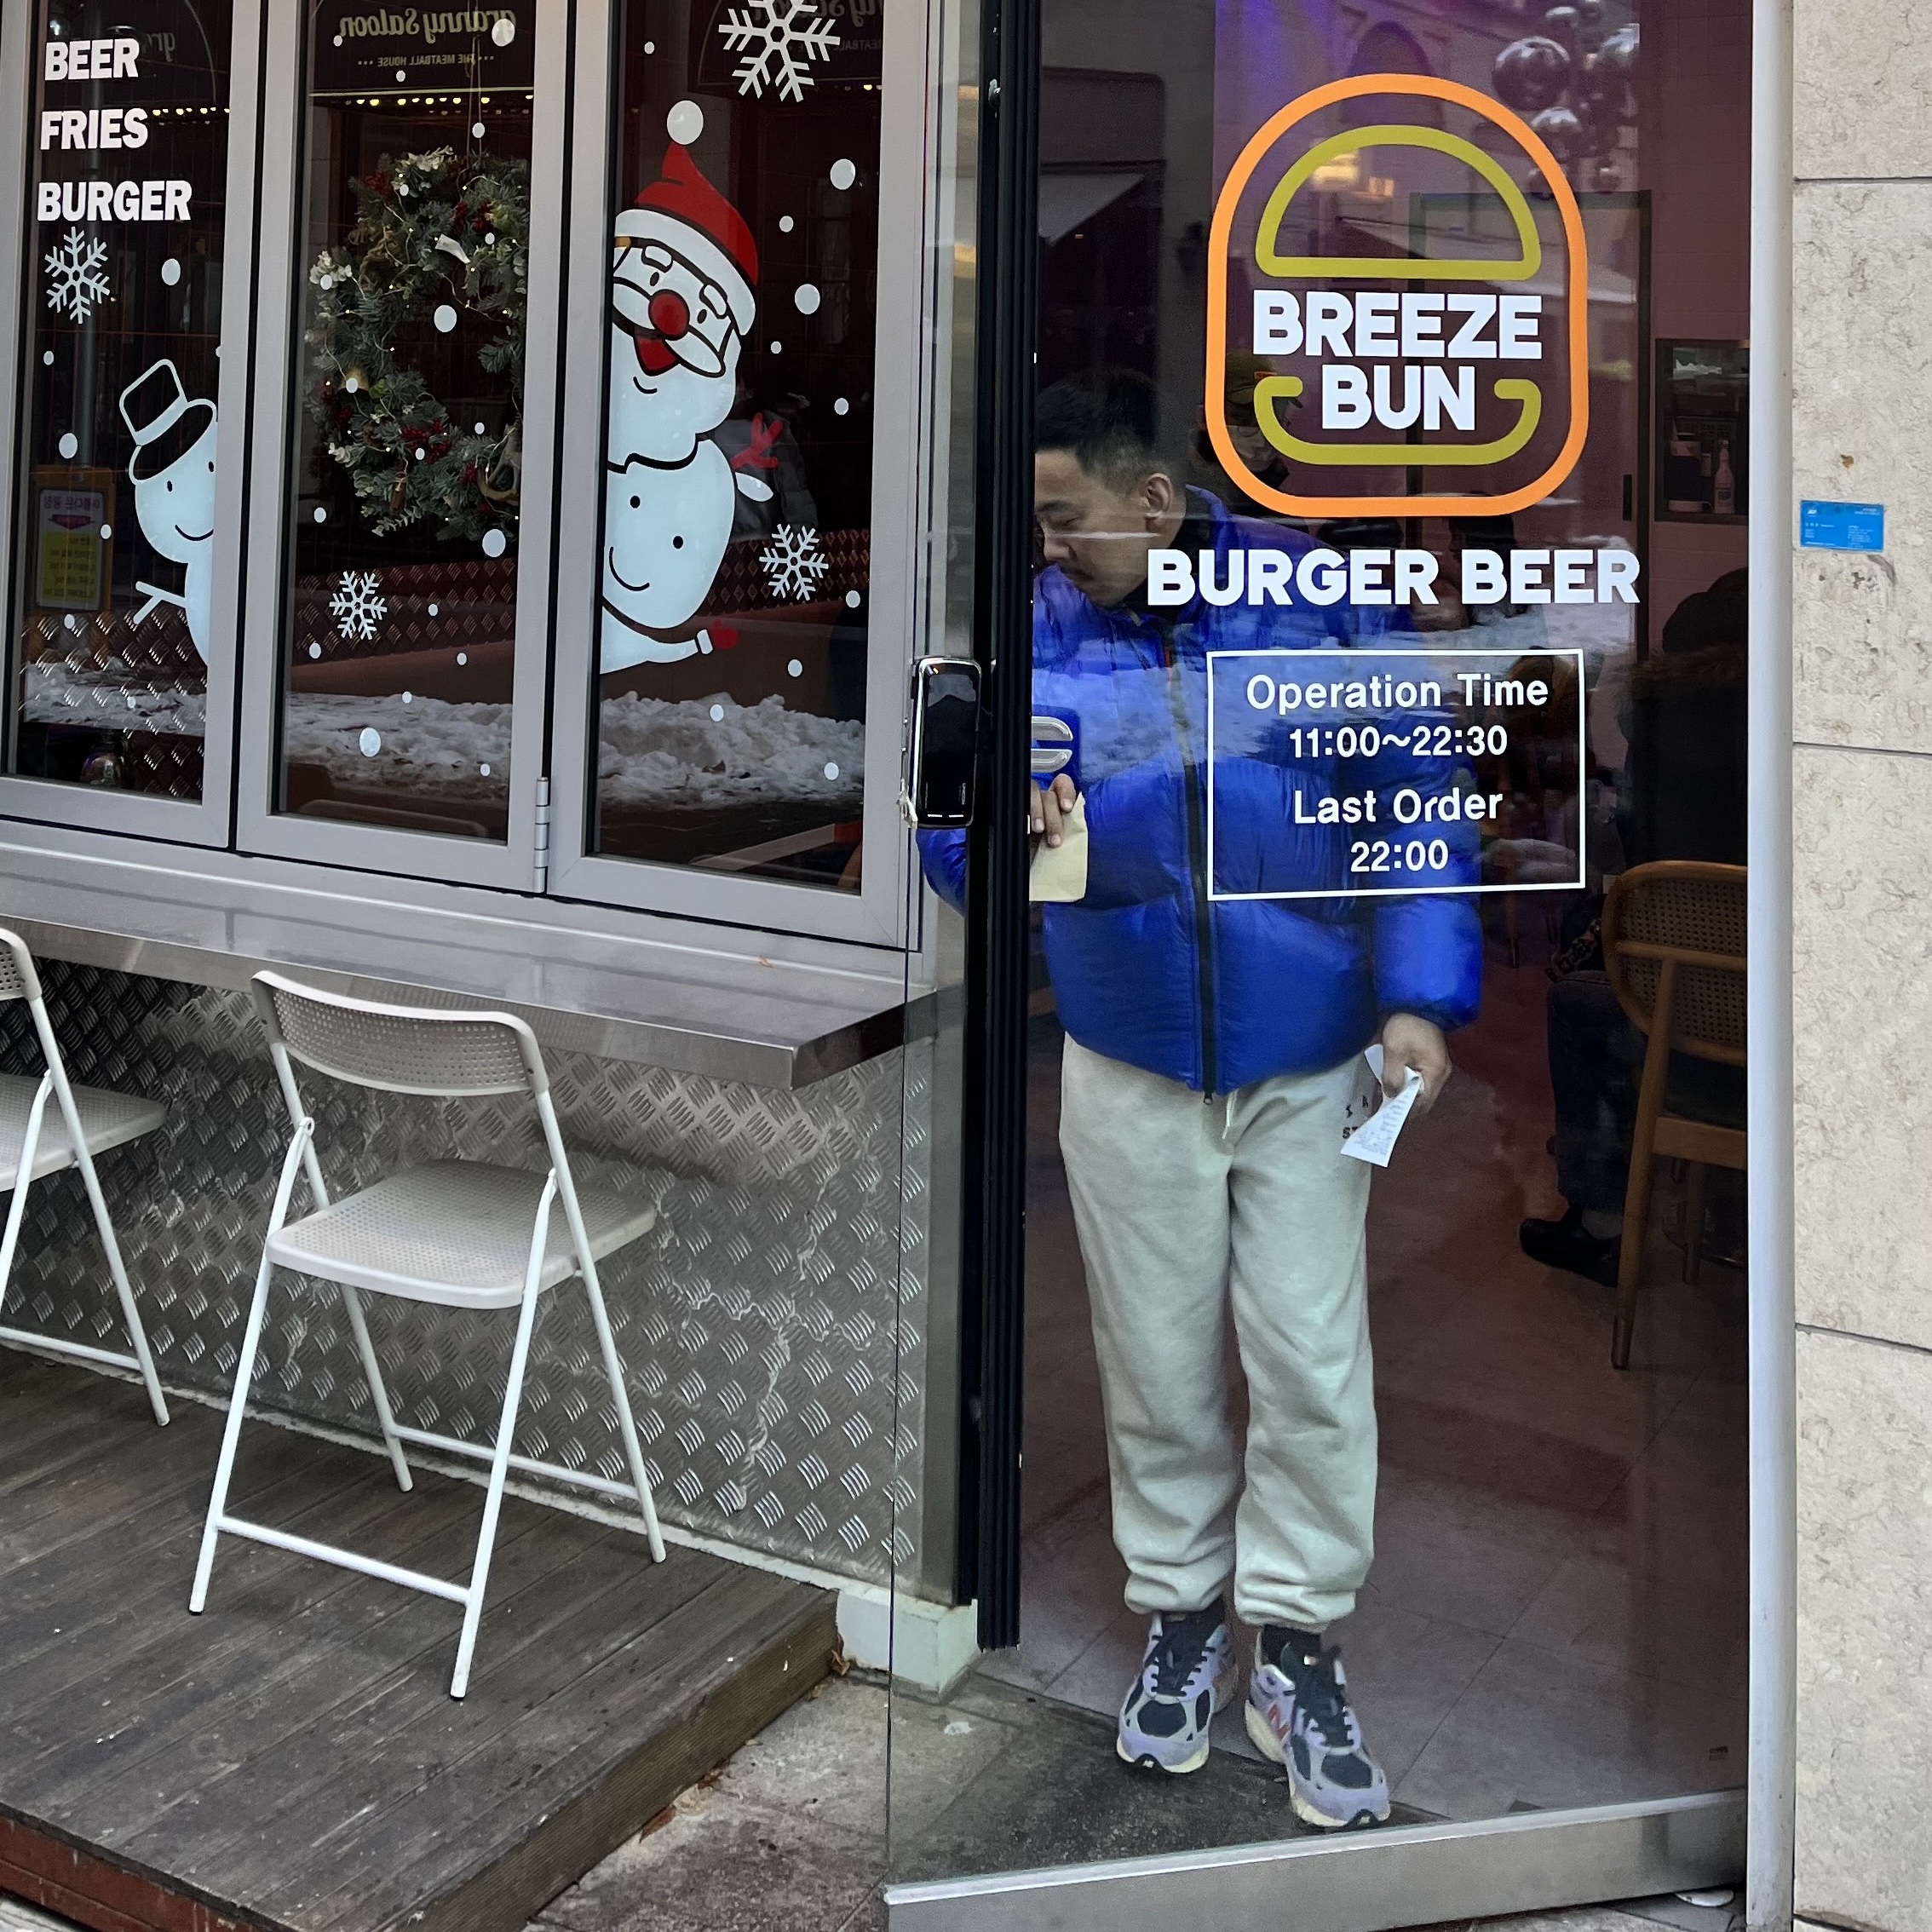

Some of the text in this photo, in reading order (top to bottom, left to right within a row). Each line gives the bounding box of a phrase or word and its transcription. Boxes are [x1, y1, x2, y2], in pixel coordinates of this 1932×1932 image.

[45, 38, 140, 80] BEER
[41, 108, 148, 150] FRIES
[37, 181, 192, 221] BURGER
[1253, 290, 1542, 359] BREEZE
[1322, 365, 1475, 430] BUN
[1147, 549, 1640, 606] BURGER BEER
[1247, 673, 1549, 716] Operation Time
[1290, 726, 1508, 758] 11:00~22:30
[1295, 787, 1504, 824] Last Order
[1351, 840, 1449, 872] 22:00
